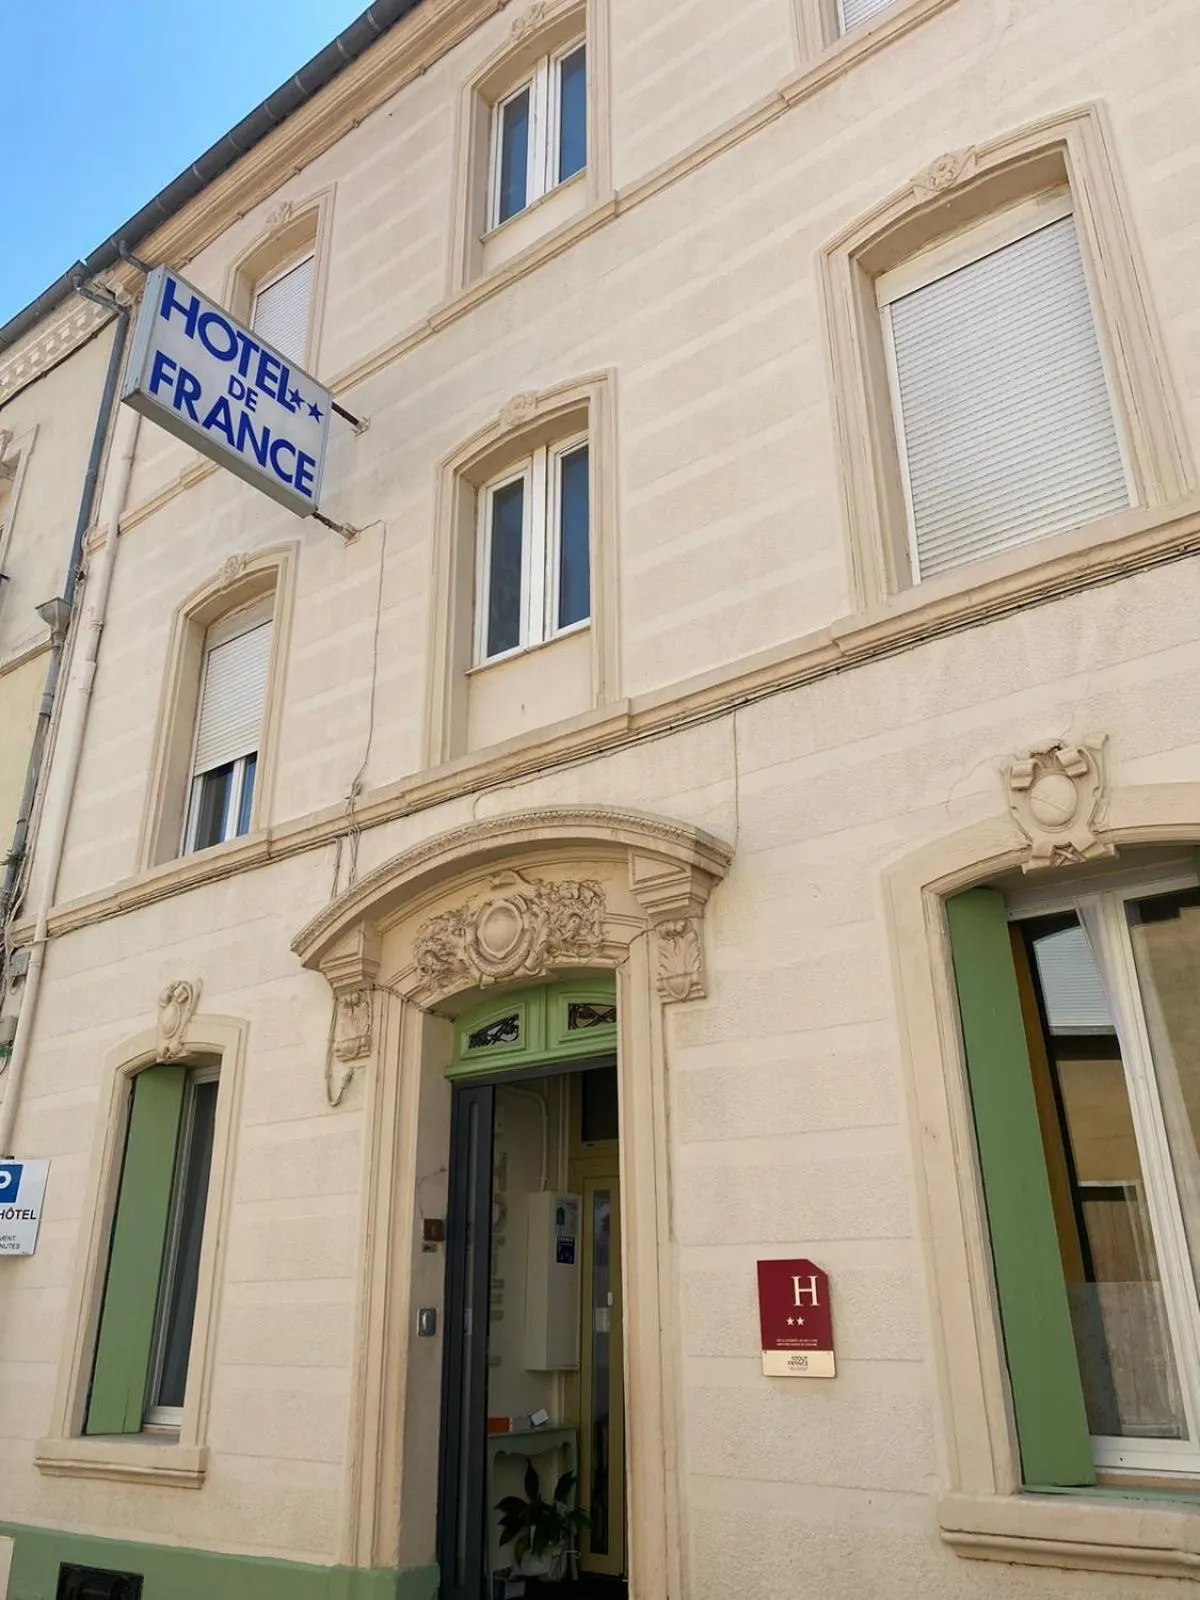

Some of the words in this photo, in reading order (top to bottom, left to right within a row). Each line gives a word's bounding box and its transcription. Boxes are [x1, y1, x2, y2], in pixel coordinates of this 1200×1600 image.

[160, 277, 296, 414] HOTEL
[150, 350, 316, 498] FRANCE
[227, 374, 258, 413] DE
[791, 1275, 820, 1307] H
